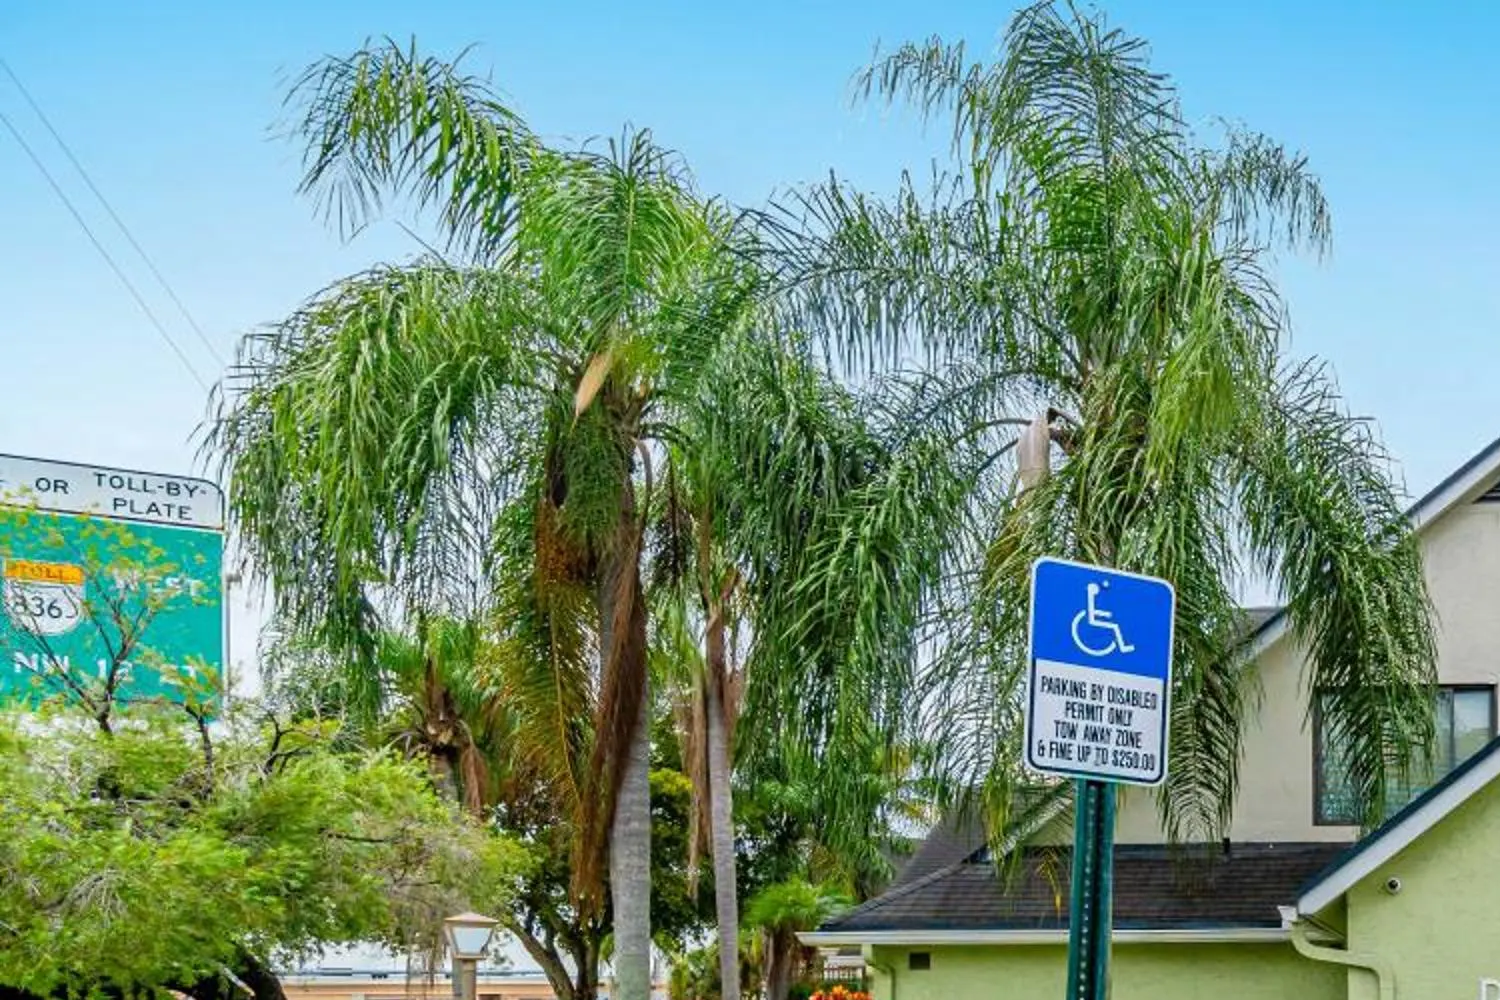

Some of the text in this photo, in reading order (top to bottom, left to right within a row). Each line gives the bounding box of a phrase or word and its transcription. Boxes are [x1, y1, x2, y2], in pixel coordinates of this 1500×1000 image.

[35, 477, 69, 495] OR
[113, 498, 193, 521] PLATE
[1040, 675, 1157, 710] PARKING BY DISABLED
[1065, 701, 1133, 727] PERMIT ONLY
[1054, 720, 1142, 749] TOW AWAY ZONE
[1037, 740, 1155, 771] & FINE UP TO $250.00
